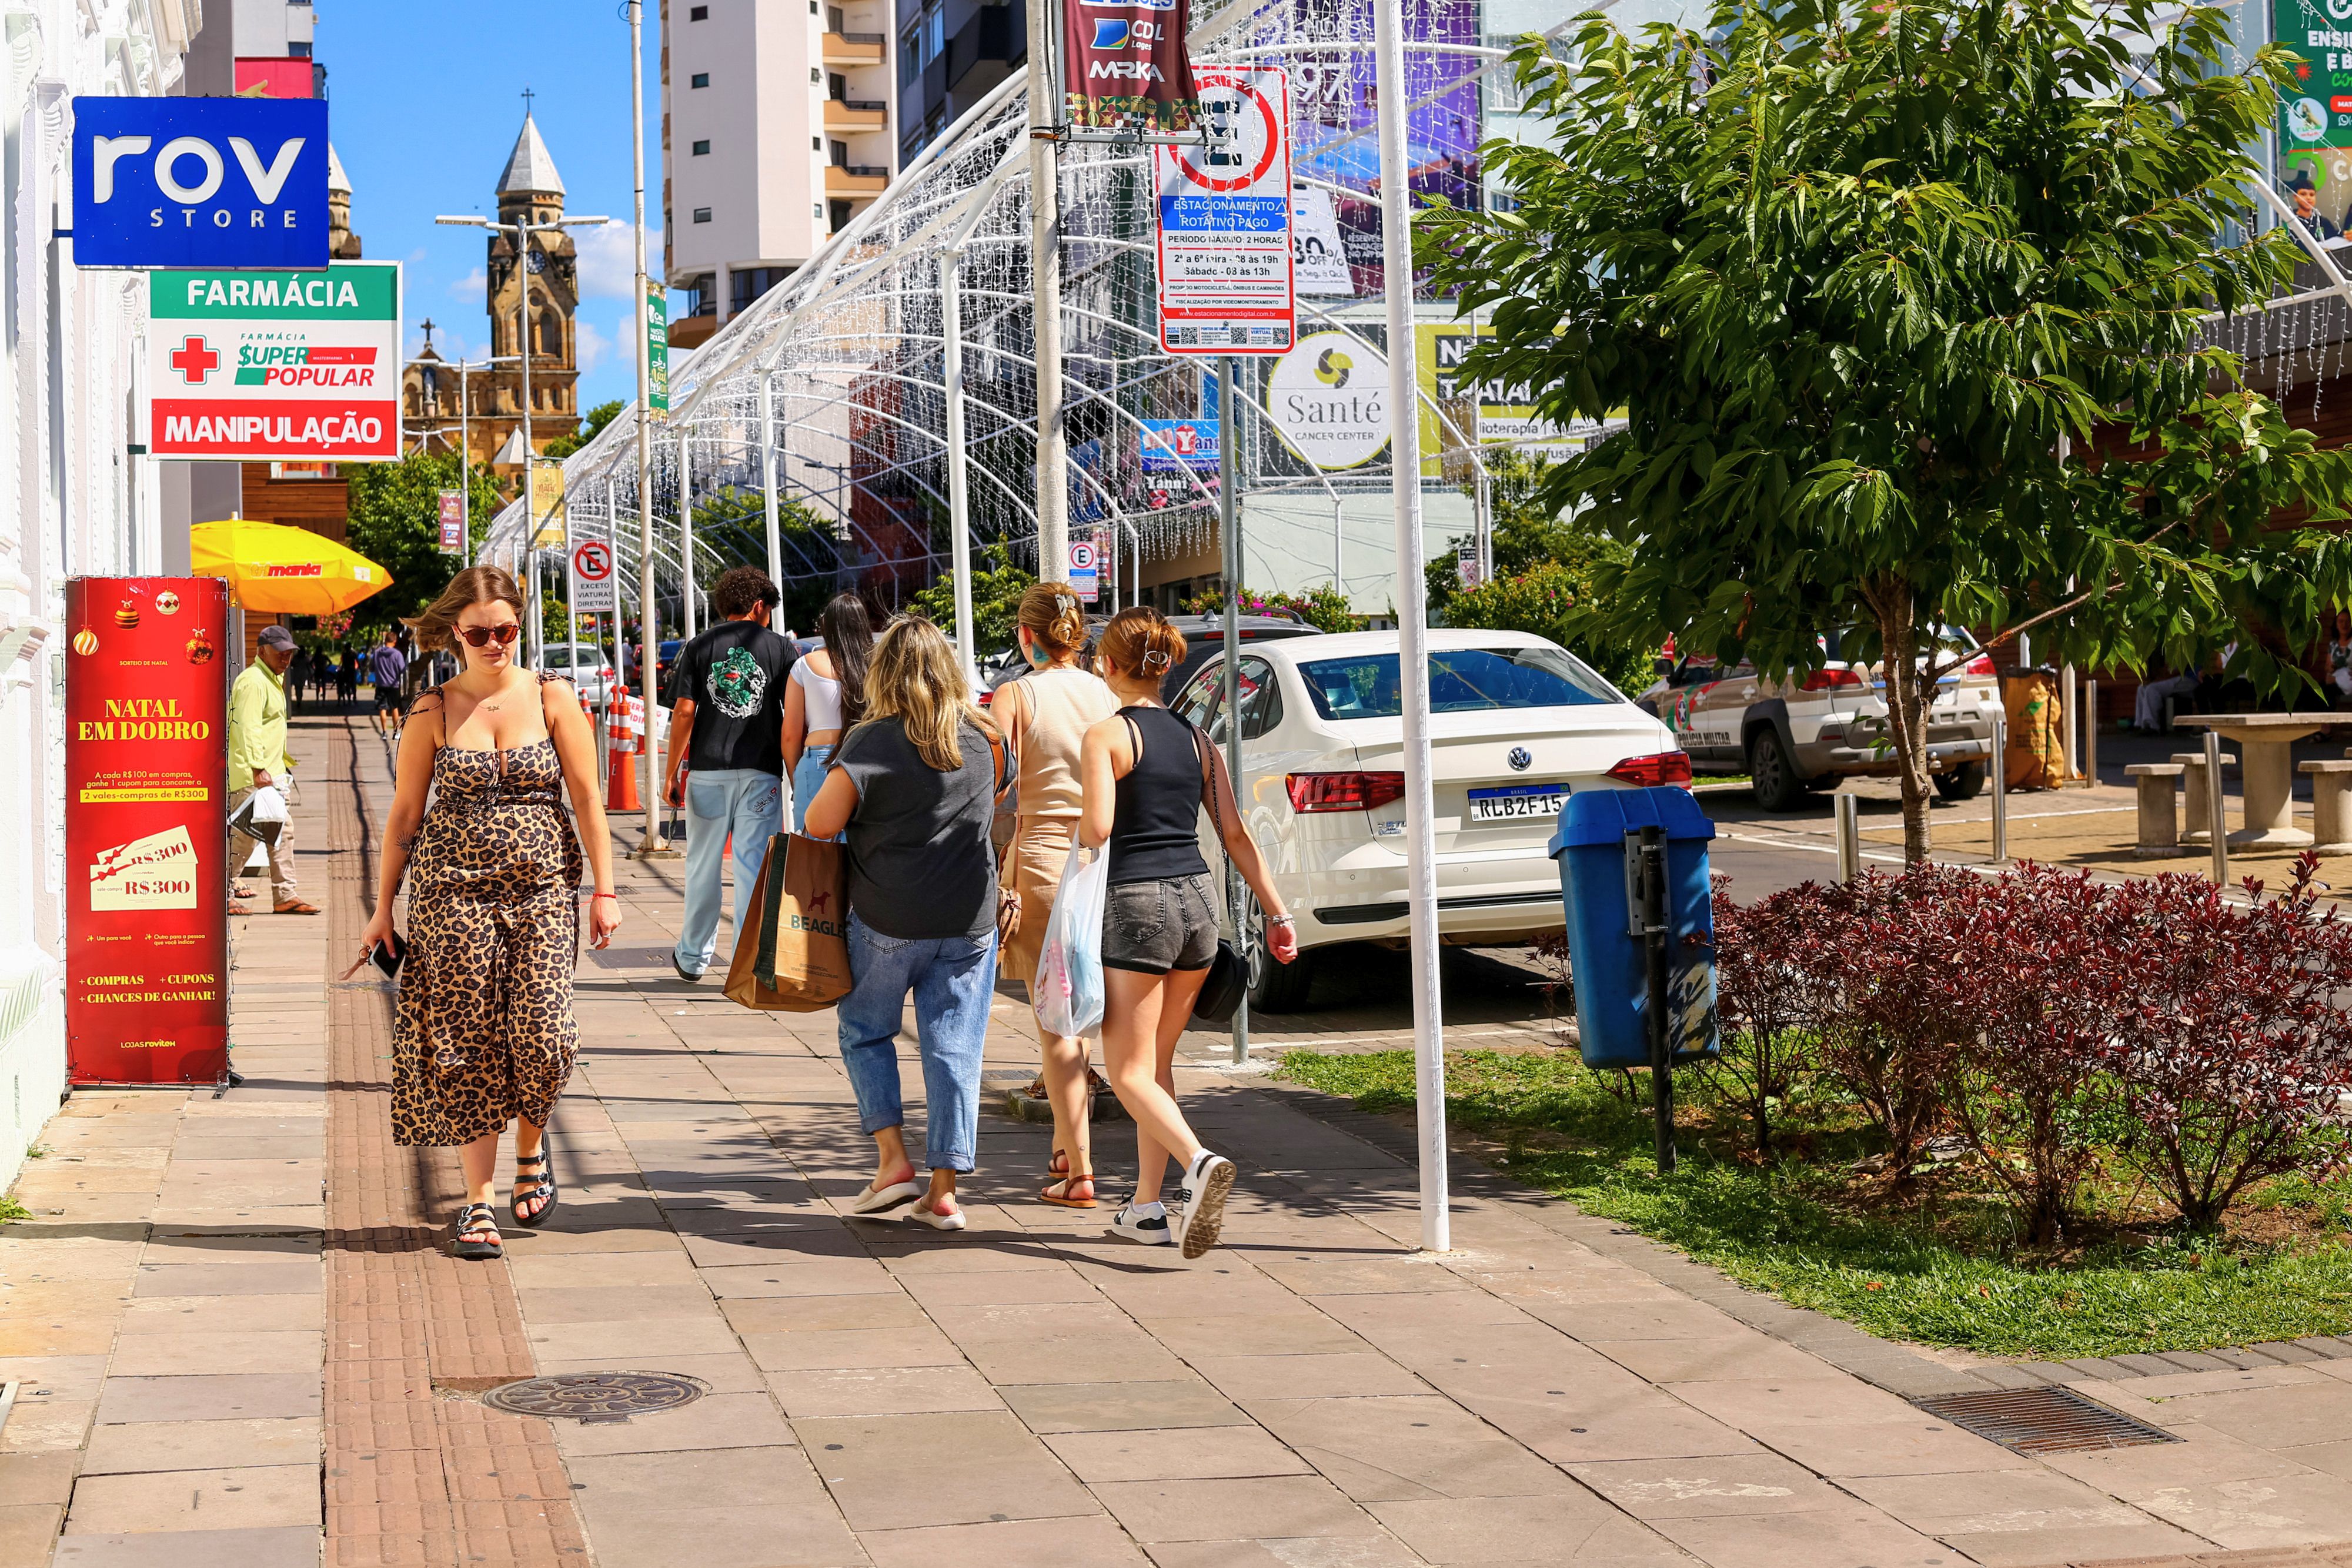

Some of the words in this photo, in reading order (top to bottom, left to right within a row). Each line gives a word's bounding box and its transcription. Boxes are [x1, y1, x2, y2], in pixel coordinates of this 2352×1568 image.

[1131, 20, 1164, 41] CDL
[1132, 41, 1152, 51] Lages
[1089, 60, 1165, 82] MRKA
[1202, 101, 1242, 166] E
[93, 135, 306, 205] rov
[1174, 200, 1275, 210] ESTACIONAMENTO
[150, 208, 297, 228] STORE
[1181, 218, 1235, 227] ROTATIVO
[1238, 218, 1269, 228] PAGO
[1168, 234, 1206, 243] PERÍODO
[1248, 255, 1259, 263] às
[187, 274, 359, 307] FARMÁCIA
[240, 332, 306, 340] FARMÁCIA
[263, 367, 375, 386] POPULAR
[1288, 393, 1382, 424] Santé
[164, 410, 382, 449] MANIPULAÇÃO
[1295, 432, 1333, 441] CANCER
[1336, 431, 1375, 440] CENTER
[1146, 476, 1188, 489] Yanni
[1078, 550, 1086, 563] E
[249, 562, 323, 578] trimania
[105, 699, 182, 718] NATAL
[78, 721, 115, 741] EM
[119, 721, 209, 740] DOBRO
[1678, 731, 1704, 747] POLÍCIA
[1703, 731, 1731, 746] MILITAR
[86, 779, 109, 788] ganhe
[143, 780, 160, 788] para
[93, 791, 158, 800] vales-compras
[174, 790, 205, 798] R$300
[1479, 794, 1561, 817] RLB2F15
[154, 842, 187, 862] 300
[153, 880, 190, 894] 300
[791, 915, 843, 939] BEAGLE
[87, 975, 145, 986] COMPRAS
[167, 974, 215, 984] CUPONS
[87, 992, 142, 1004] CHANCES
[144, 992, 161, 1002] DE
[162, 991, 216, 1001] GANHAR!
